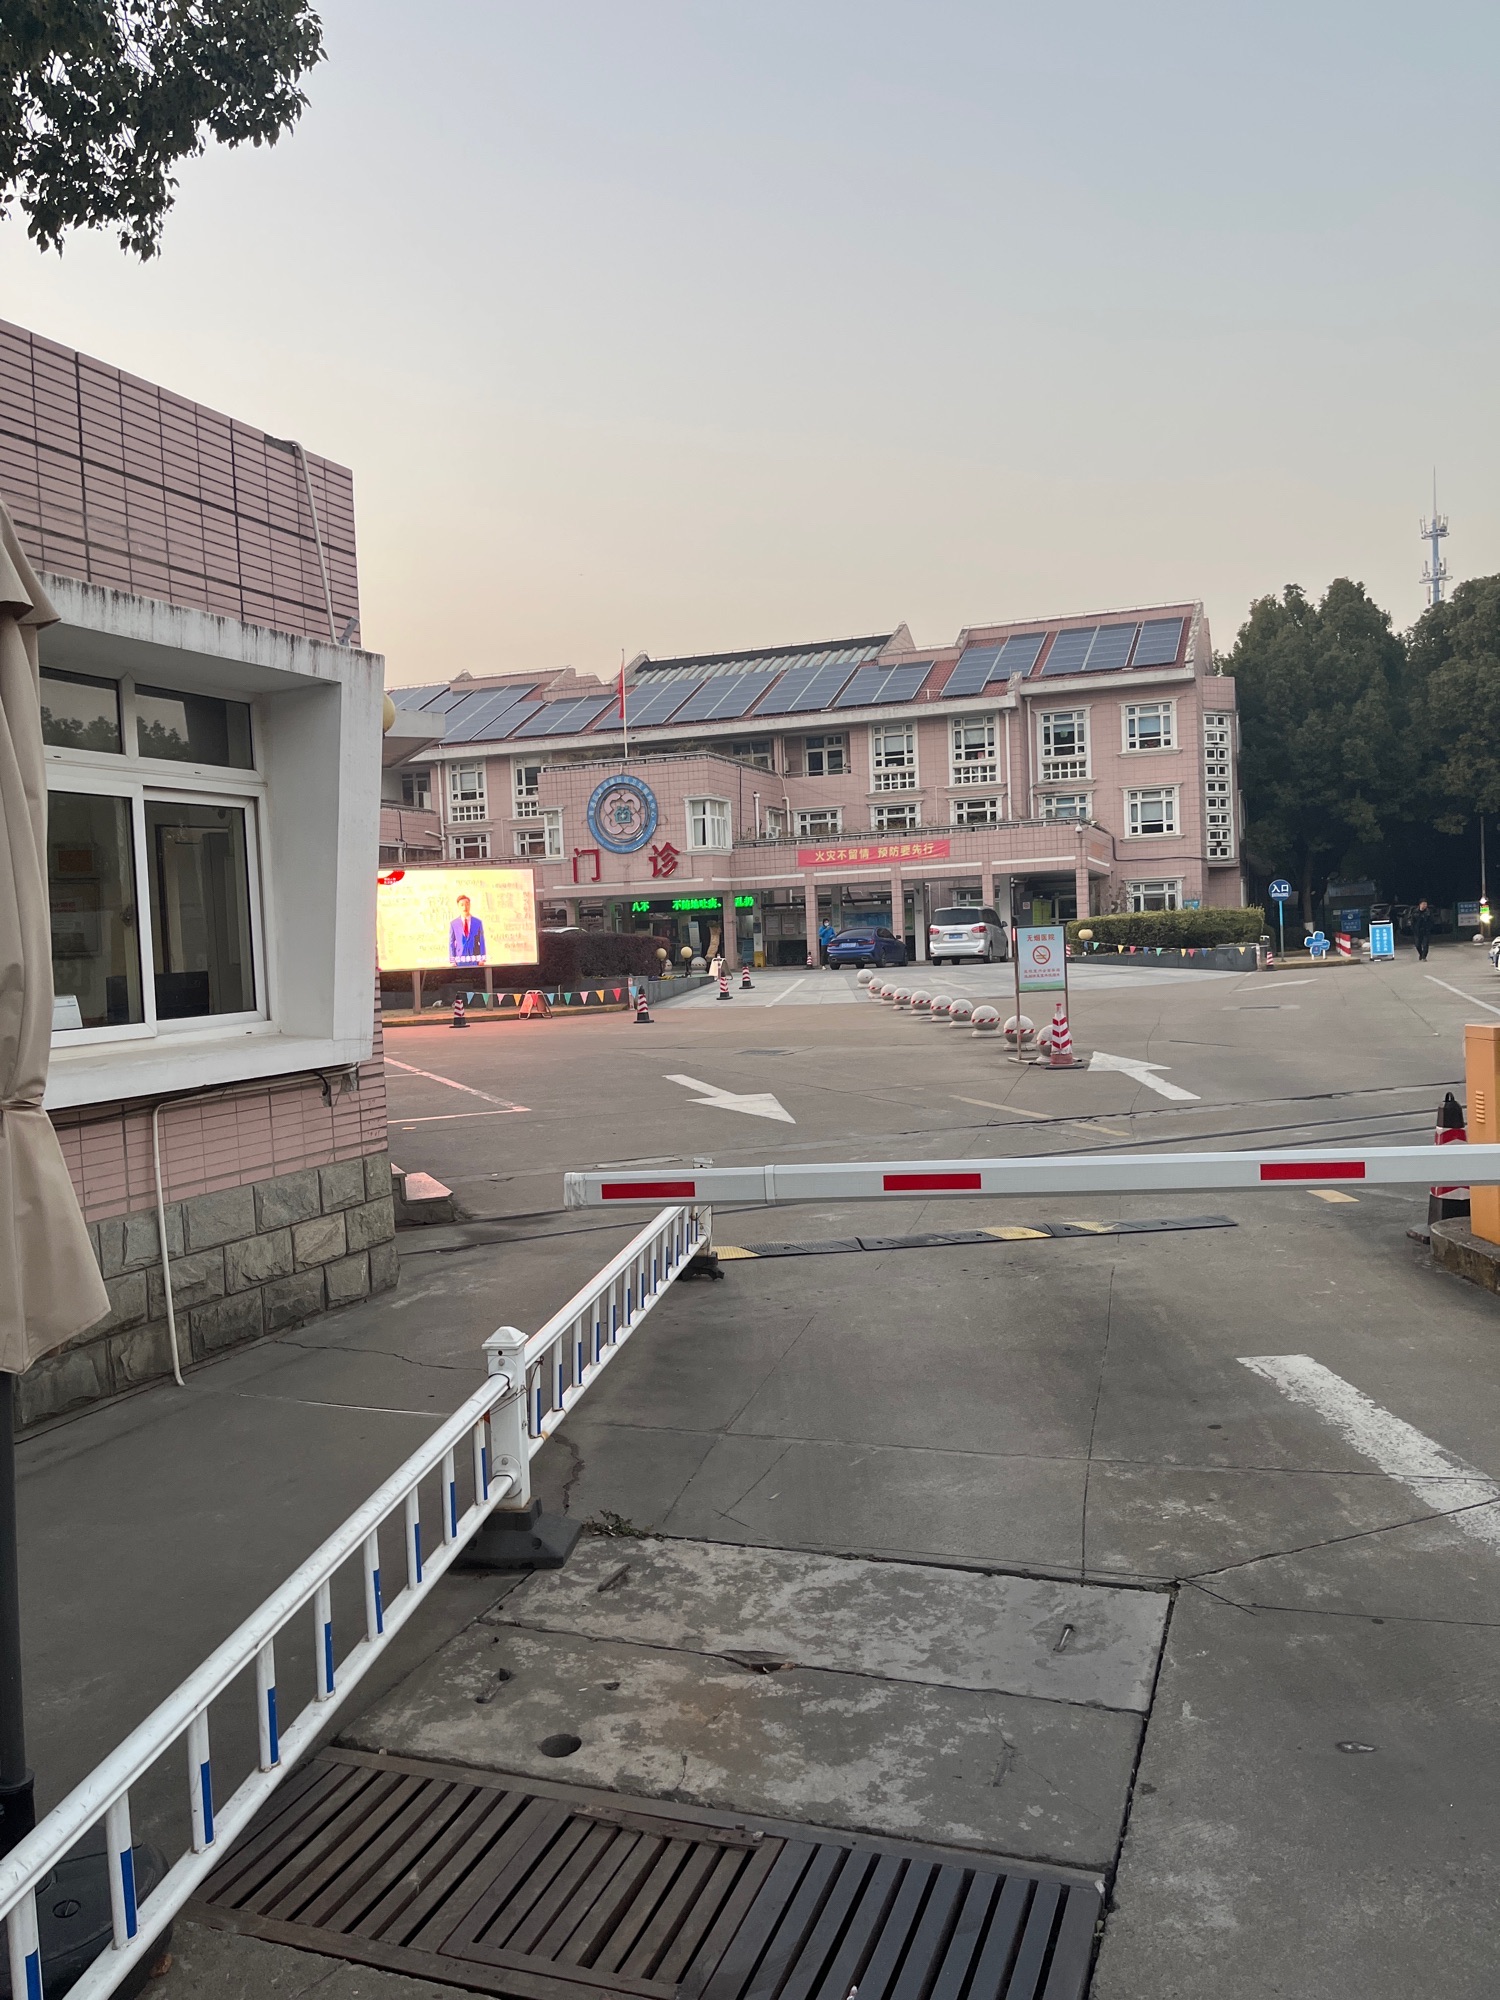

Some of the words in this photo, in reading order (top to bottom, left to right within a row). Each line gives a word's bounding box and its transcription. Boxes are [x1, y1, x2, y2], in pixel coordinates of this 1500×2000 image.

[815, 848, 870, 862] 火灾不留情
[877, 842, 935, 858] 预防要先行
[572, 841, 681, 884] 门诊
[1271, 884, 1289, 893] 入口
[1026, 933, 1055, 942] 无烟医院
